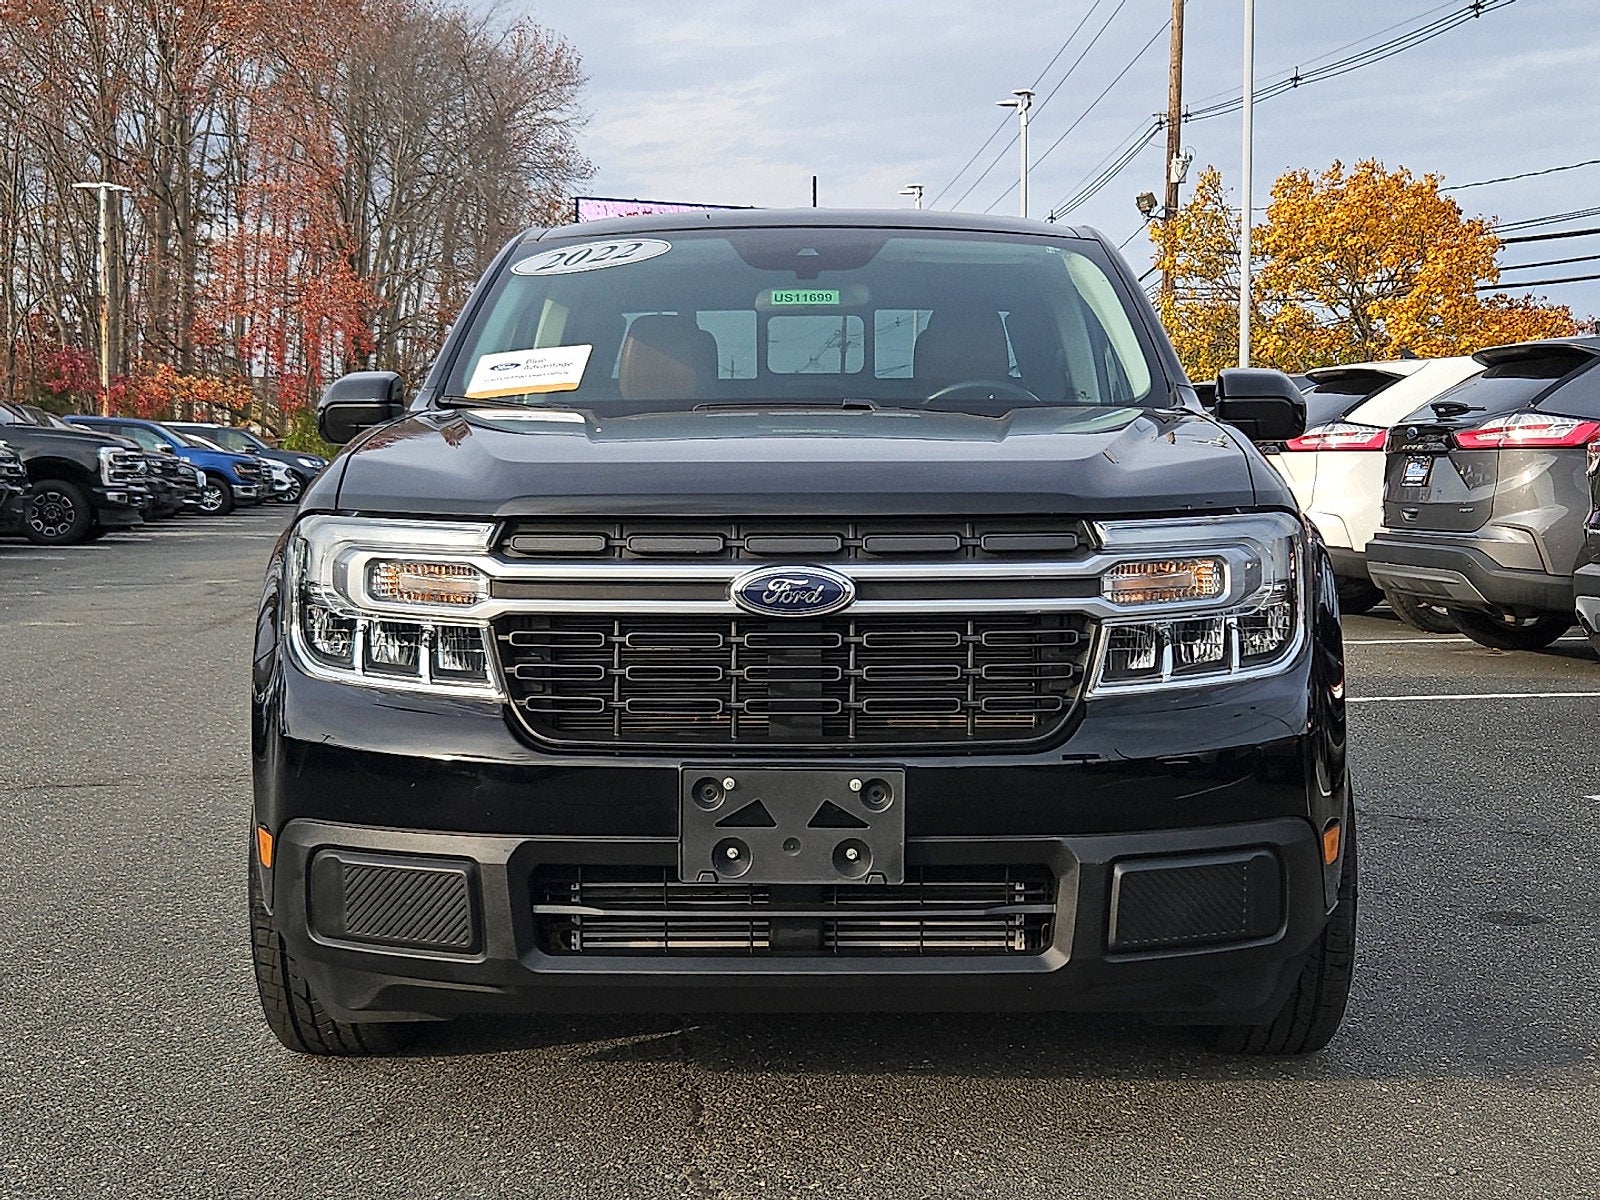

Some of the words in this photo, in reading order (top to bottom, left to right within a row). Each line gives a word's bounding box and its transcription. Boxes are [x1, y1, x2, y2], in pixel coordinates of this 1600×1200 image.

[534, 242, 643, 271] 2022
[774, 293, 833, 302] US11699
[762, 578, 825, 604] Ford
